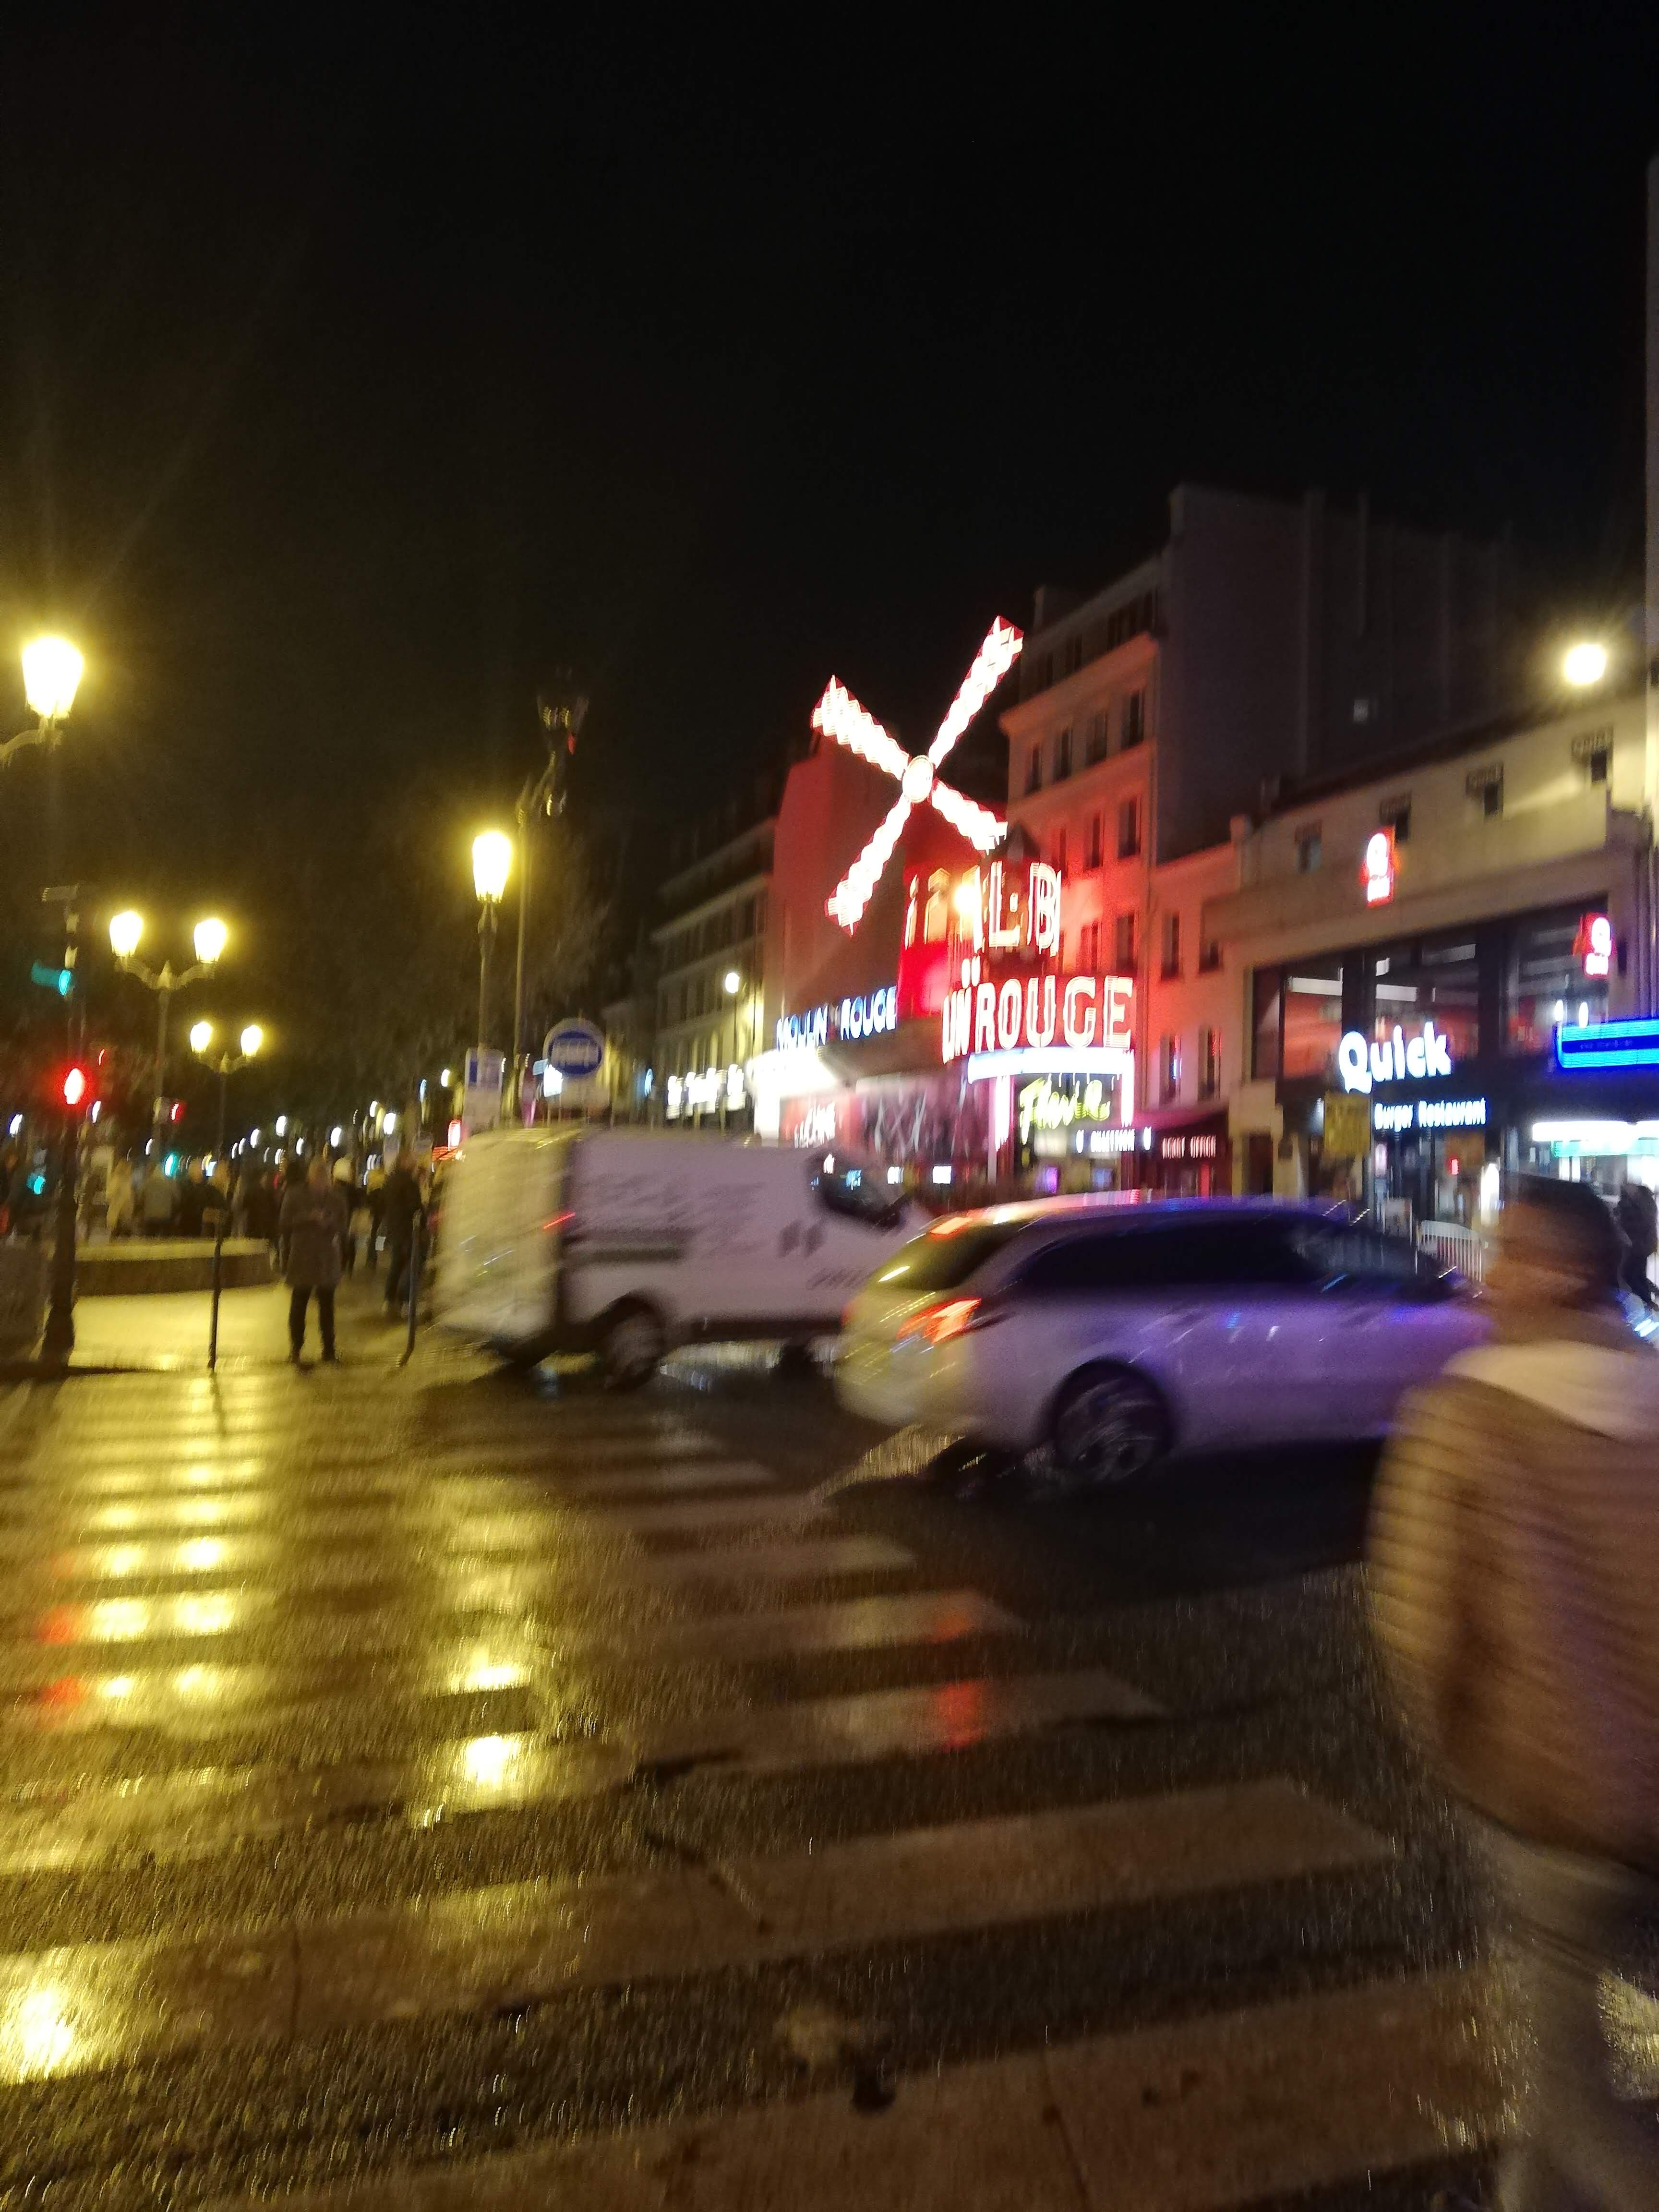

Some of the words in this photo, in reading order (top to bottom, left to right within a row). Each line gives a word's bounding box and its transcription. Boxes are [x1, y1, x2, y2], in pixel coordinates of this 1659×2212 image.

[840, 986, 897, 1041] ROUGE
[975, 975, 1133, 1054] ROUGE
[1339, 1021, 1452, 1094] Quick
